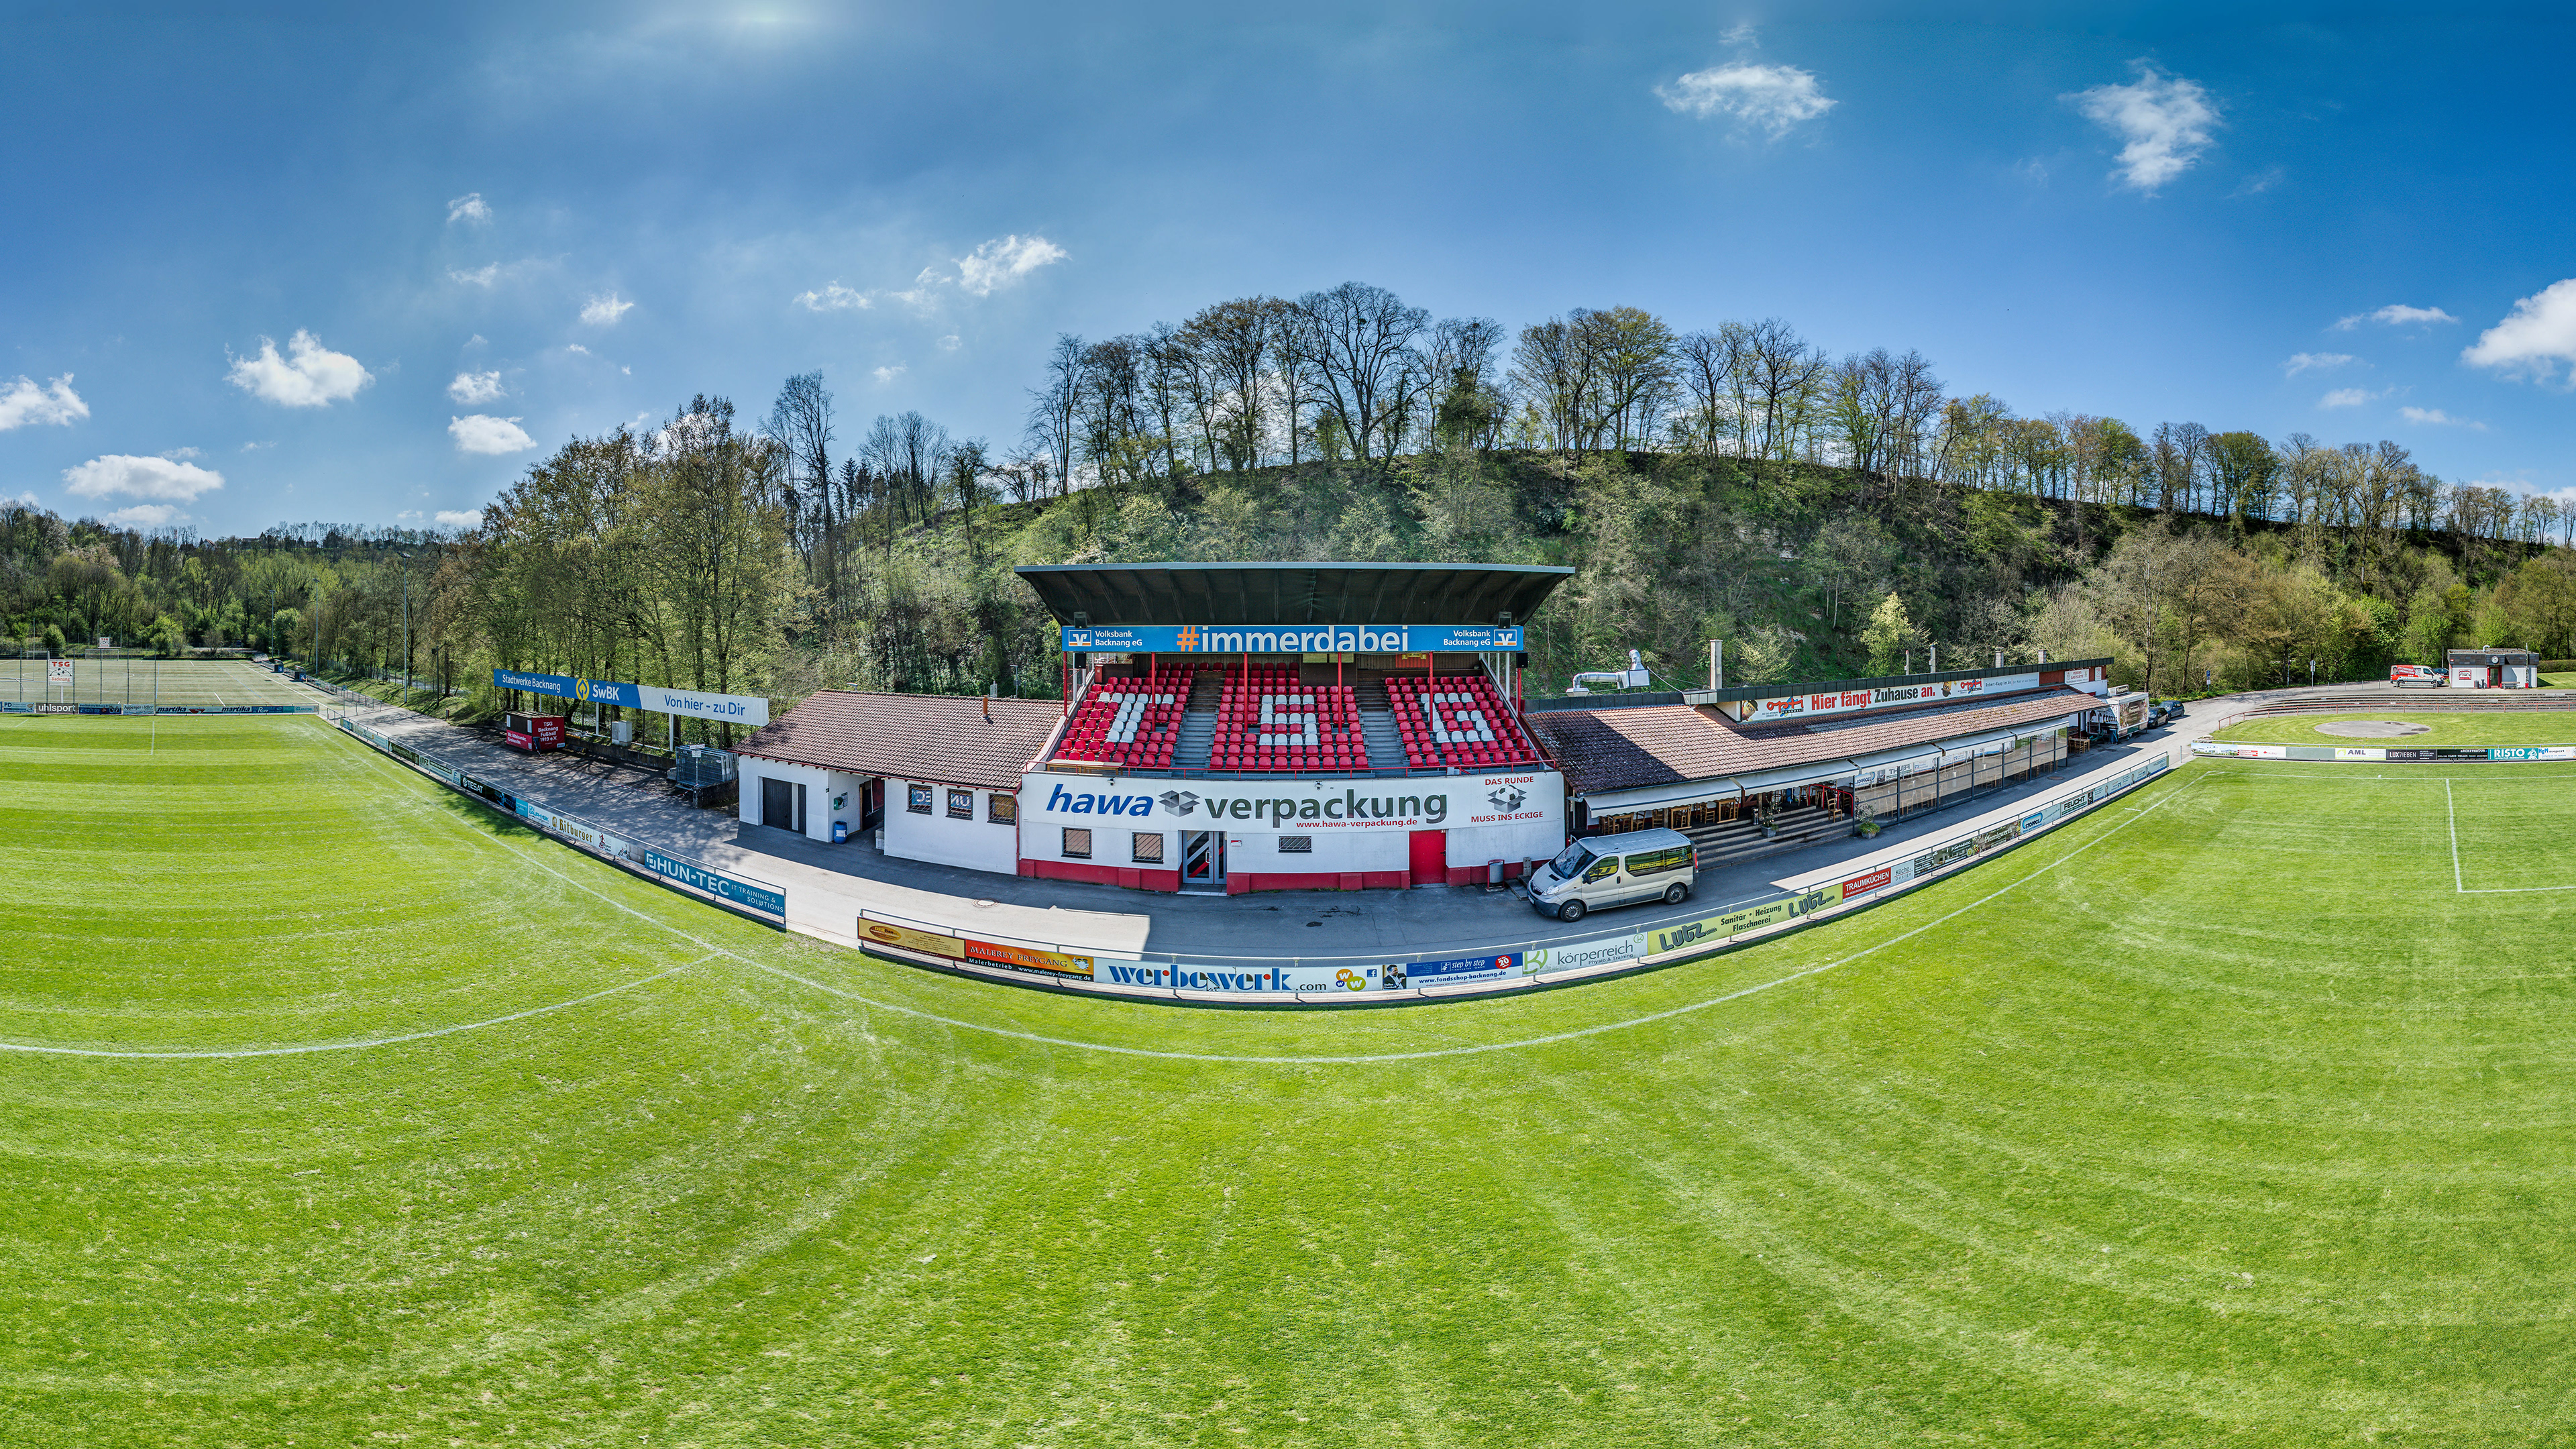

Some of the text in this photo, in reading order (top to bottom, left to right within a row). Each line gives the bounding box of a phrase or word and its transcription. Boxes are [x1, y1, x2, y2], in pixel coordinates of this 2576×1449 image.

[1095, 630, 1132, 638] Volksbank
[1177, 626, 1408, 652] #immerdabei
[1095, 639, 1142, 647] Backnang eG
[1443, 638, 1491, 647] Backnang eG
[502, 674, 561, 694] Stadtwerke Backnang
[1960, 678, 1982, 690] opti
[592, 684, 620, 701] SwBK
[1811, 685, 1935, 711] Hier fängt Zuhause an.
[38, 704, 76, 713] uhlsport
[664, 694, 682, 707] Von
[684, 696, 704, 711] hier
[713, 703, 726, 714] zu
[728, 702, 746, 716] Dir
[1766, 695, 1804, 714] opti
[2494, 749, 2525, 757] RISTO
[467, 780, 484, 794] TESAT
[1485, 776, 1534, 786] DAS RUNDE
[1046, 783, 1154, 816] hawa
[2063, 796, 2086, 810] FEUCHT
[1205, 789, 1447, 828] verpackung
[1296, 818, 1417, 828] www.hawa-verpackung.de
[1470, 810, 1544, 824] MUSS INS ECKIGE
[559, 818, 593, 843] Bitburger
[657, 857, 730, 896] HUN-TEC
[1895, 867, 1910, 875] Küche
[1895, 873, 1912, 881] Design
[1845, 870, 1890, 892] TRAUMKÜCHEN
[739, 886, 769, 901] TRAINING
[747, 896, 784, 913] SOLUTIONS
[1720, 905, 1782, 926] Sanitär Heizung
[1733, 915, 1771, 932] Flaschnerei
[969, 946, 1068, 967] MALEREY FREYGANG
[1557, 940, 1633, 966] körperreich
[1613, 953, 1633, 961] Training
[969, 957, 1091, 981] Malerbetrieb www.malerey-freygang.de
[1452, 958, 1485, 969] step by step
[1498, 958, 1509, 967] 20
[1108, 964, 1292, 991] werbewerk
[1419, 970, 1507, 984] www.fondsshop-backnang.de
